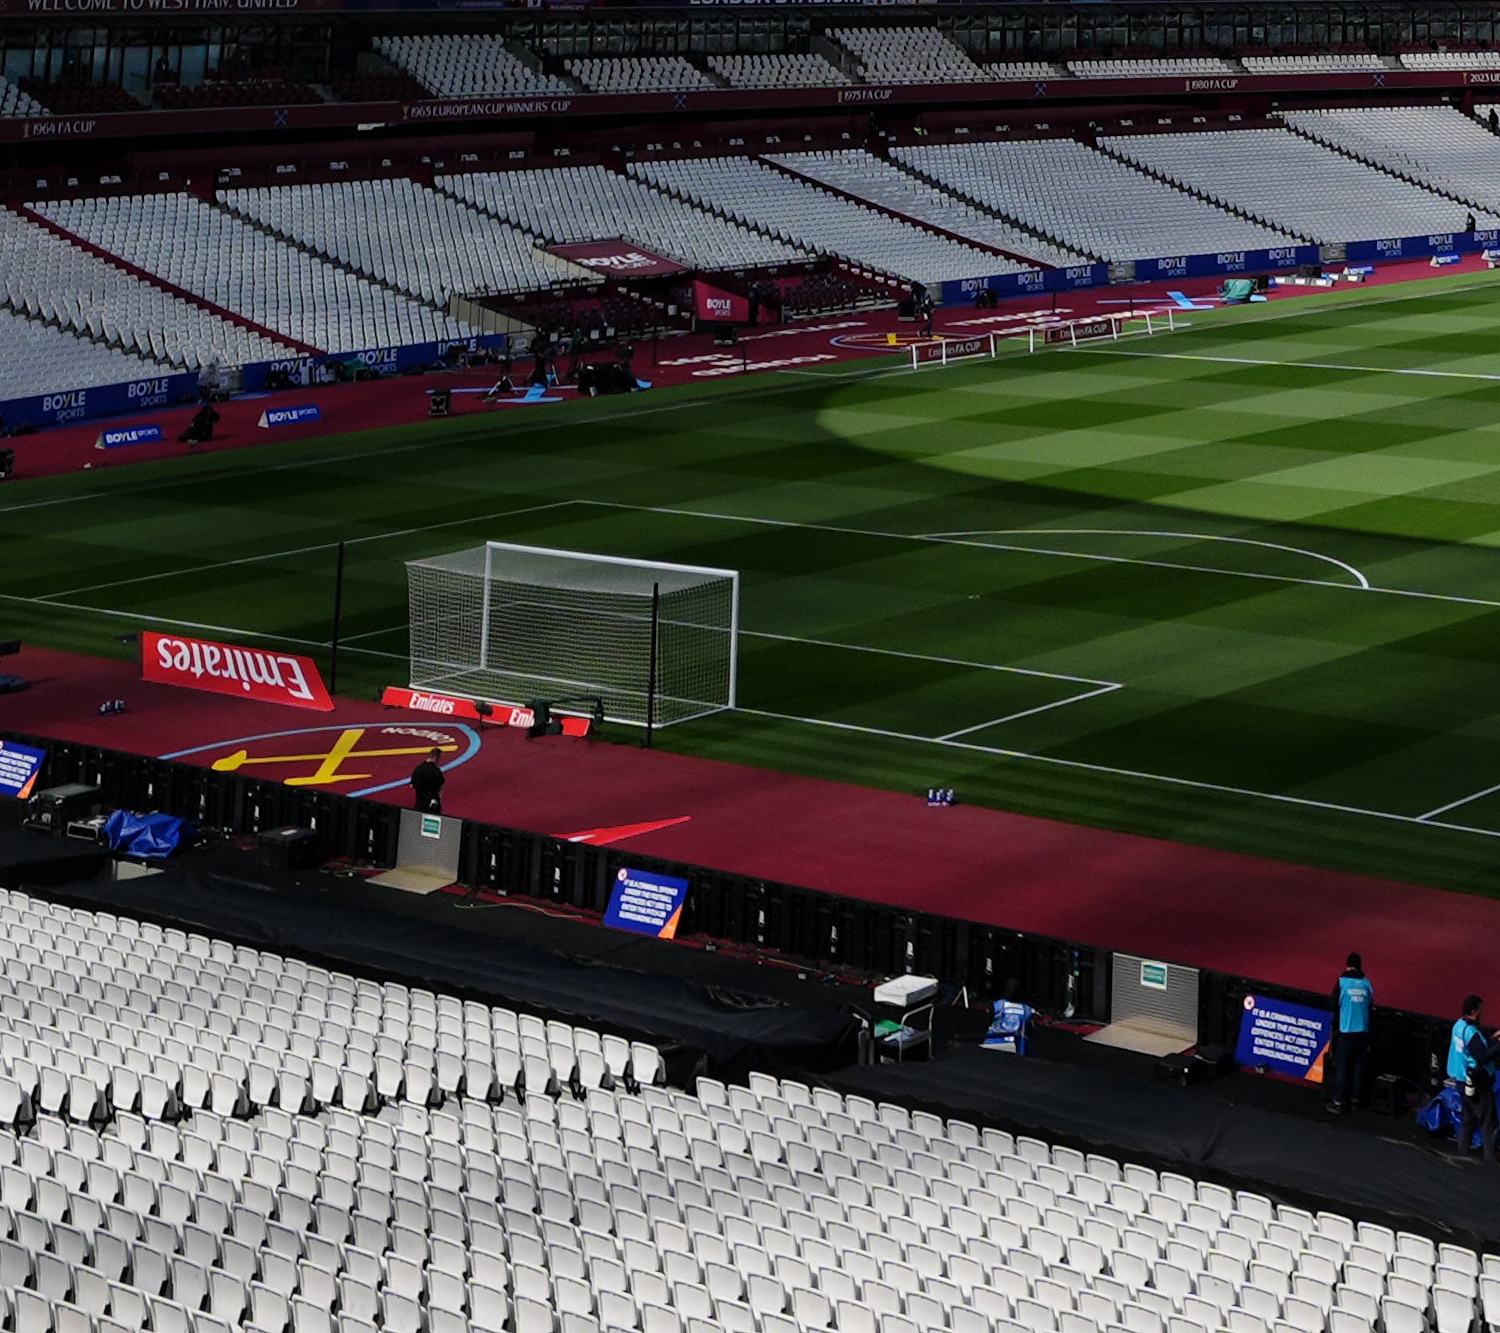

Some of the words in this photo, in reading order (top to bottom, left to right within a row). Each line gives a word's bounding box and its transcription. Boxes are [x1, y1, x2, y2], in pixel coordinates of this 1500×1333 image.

[1221, 78, 1238, 89] CUP
[874, 89, 892, 100] CUP
[432, 103, 484, 117] EUROPEAN
[484, 102, 505, 115] CUP
[550, 100, 571, 112] CUP
[32, 122, 55, 136] 1964
[72, 120, 96, 133] CUP
[1428, 234, 1453, 245] BOYLE
[1474, 230, 1498, 242] BOYLE
[1377, 239, 1402, 250] BOYLE
[1217, 252, 1245, 265] BOYLE
[1269, 248, 1295, 261] BOYLE
[1158, 256, 1187, 269] BOYLE
[1017, 271, 1044, 285] BOYLE
[1066, 266, 1092, 279] BOYLE
[961, 277, 989, 292] BOYLE
[706, 298, 732, 310] BOYLE
[966, 341, 981, 352] CUP
[128, 378, 169, 398] BOYLE
[43, 391, 86, 412] BOYLE
[140, 393, 168, 407] SPORTS
[56, 406, 85, 420] SPORTS
[269, 410, 299, 423] BOYLE
[106, 430, 138, 444] BOYLE
[138, 427, 159, 437] SPORTS
[158, 637, 315, 701] Emirates
[408, 692, 456, 715] Emirates
